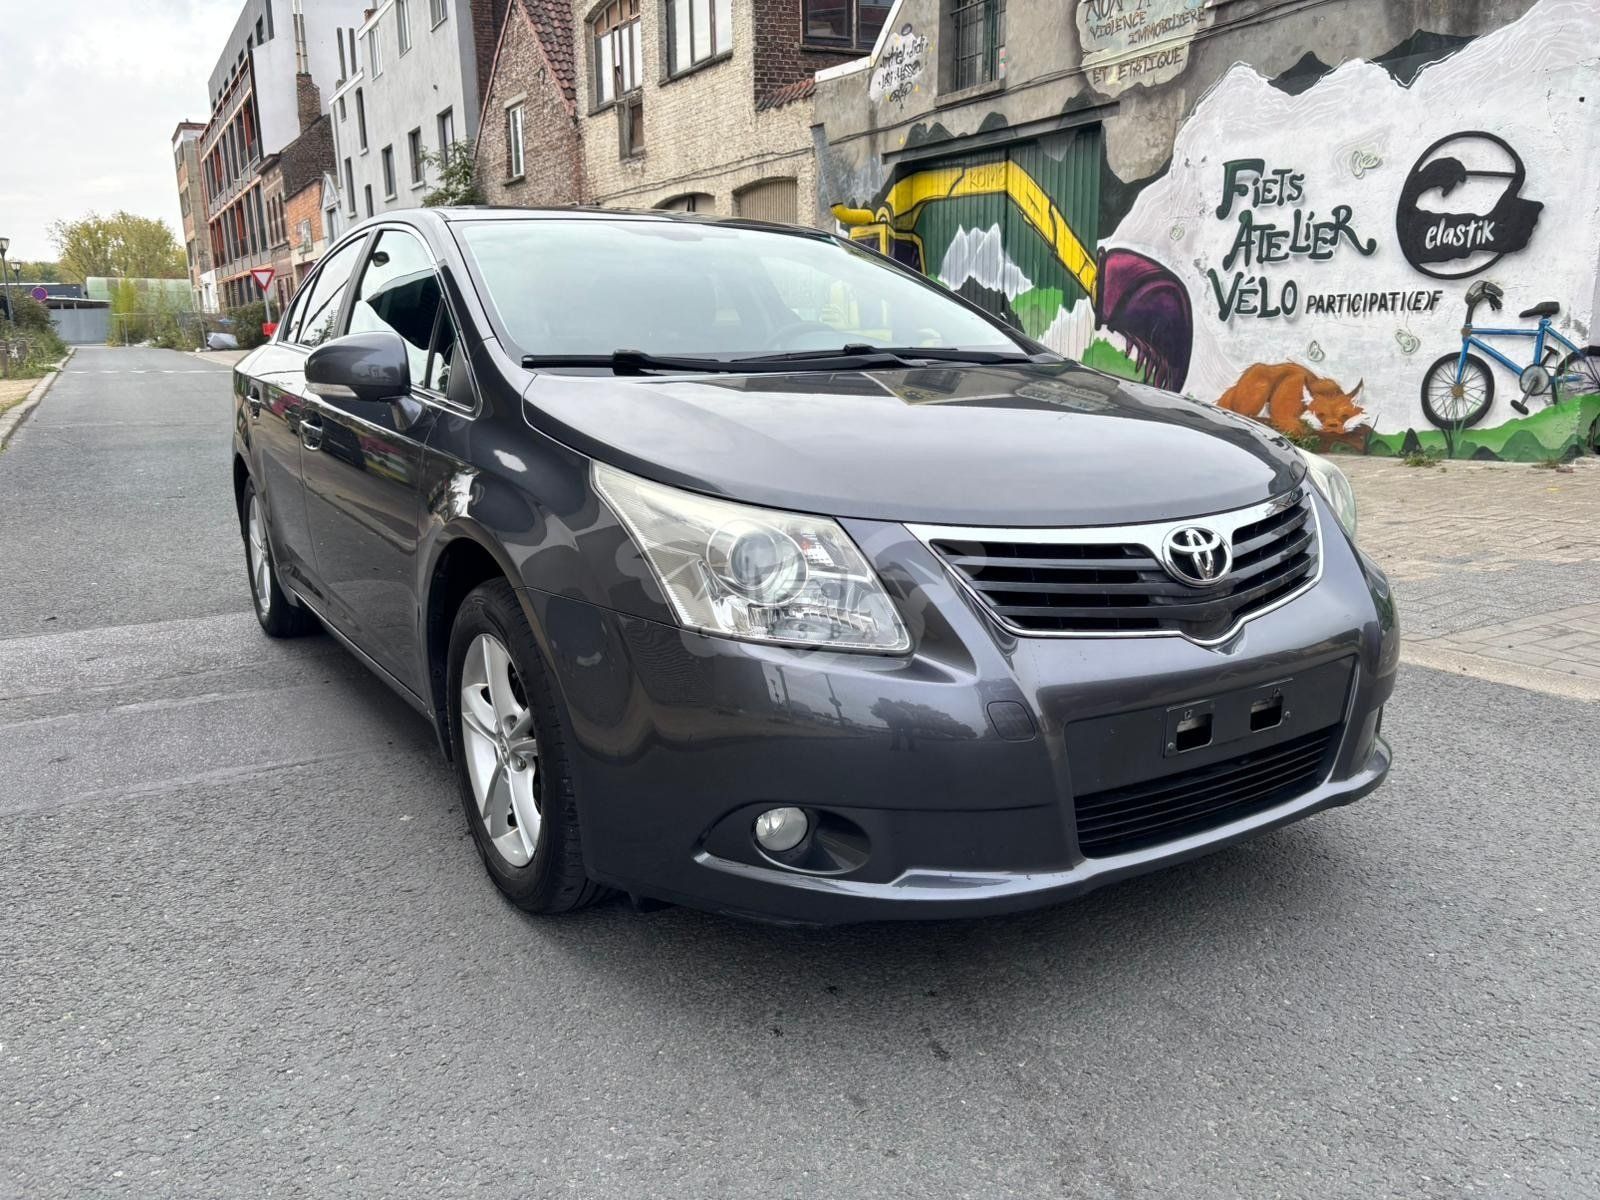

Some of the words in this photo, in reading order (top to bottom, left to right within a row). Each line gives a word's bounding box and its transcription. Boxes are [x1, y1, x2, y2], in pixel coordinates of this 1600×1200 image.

[1090, 11, 1147, 40] VIOLENCE
[1128, 6, 1205, 45] IMMOBILIÈRE
[1425, 217, 1495, 250] elastik
[1207, 268, 1298, 322] VÉLO
[1305, 290, 1443, 314] PARTICIPATI(E)F
